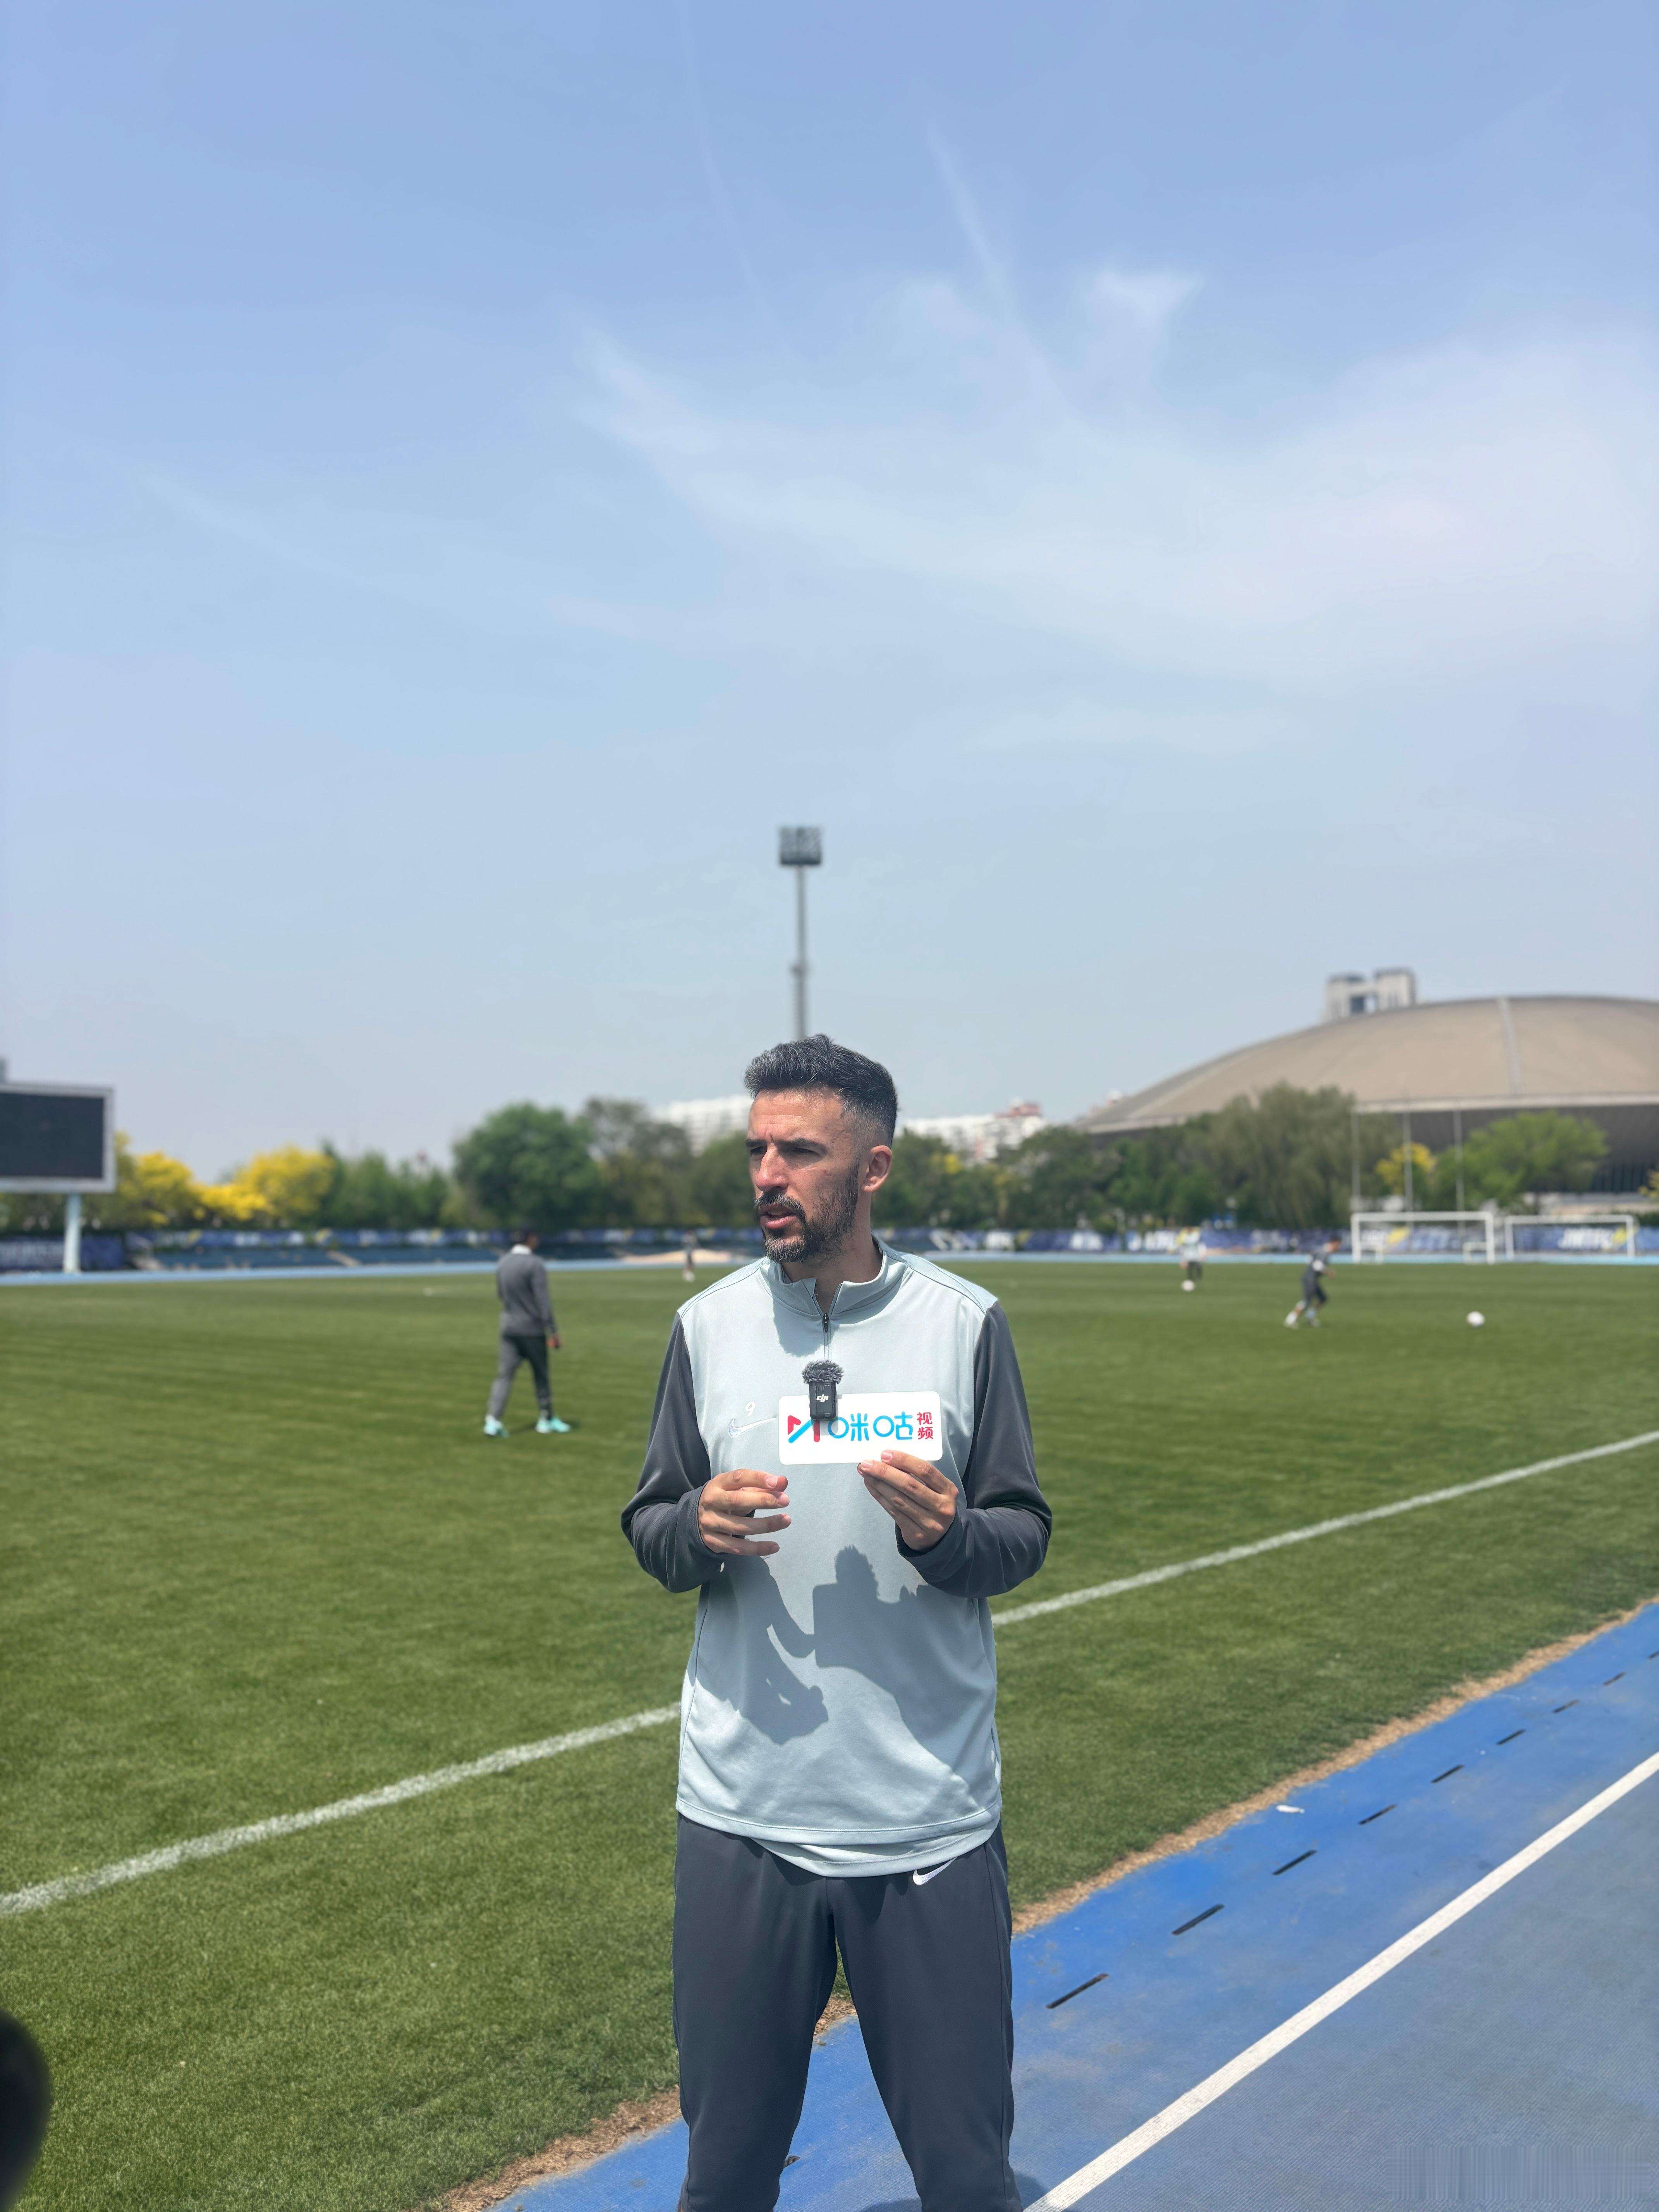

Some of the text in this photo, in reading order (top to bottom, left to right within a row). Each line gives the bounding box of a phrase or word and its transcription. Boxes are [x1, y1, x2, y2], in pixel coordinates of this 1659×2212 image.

[745, 1401, 756, 1417] 9
[828, 1411, 913, 1441] 咪咕
[917, 1412, 934, 1440] 视频
